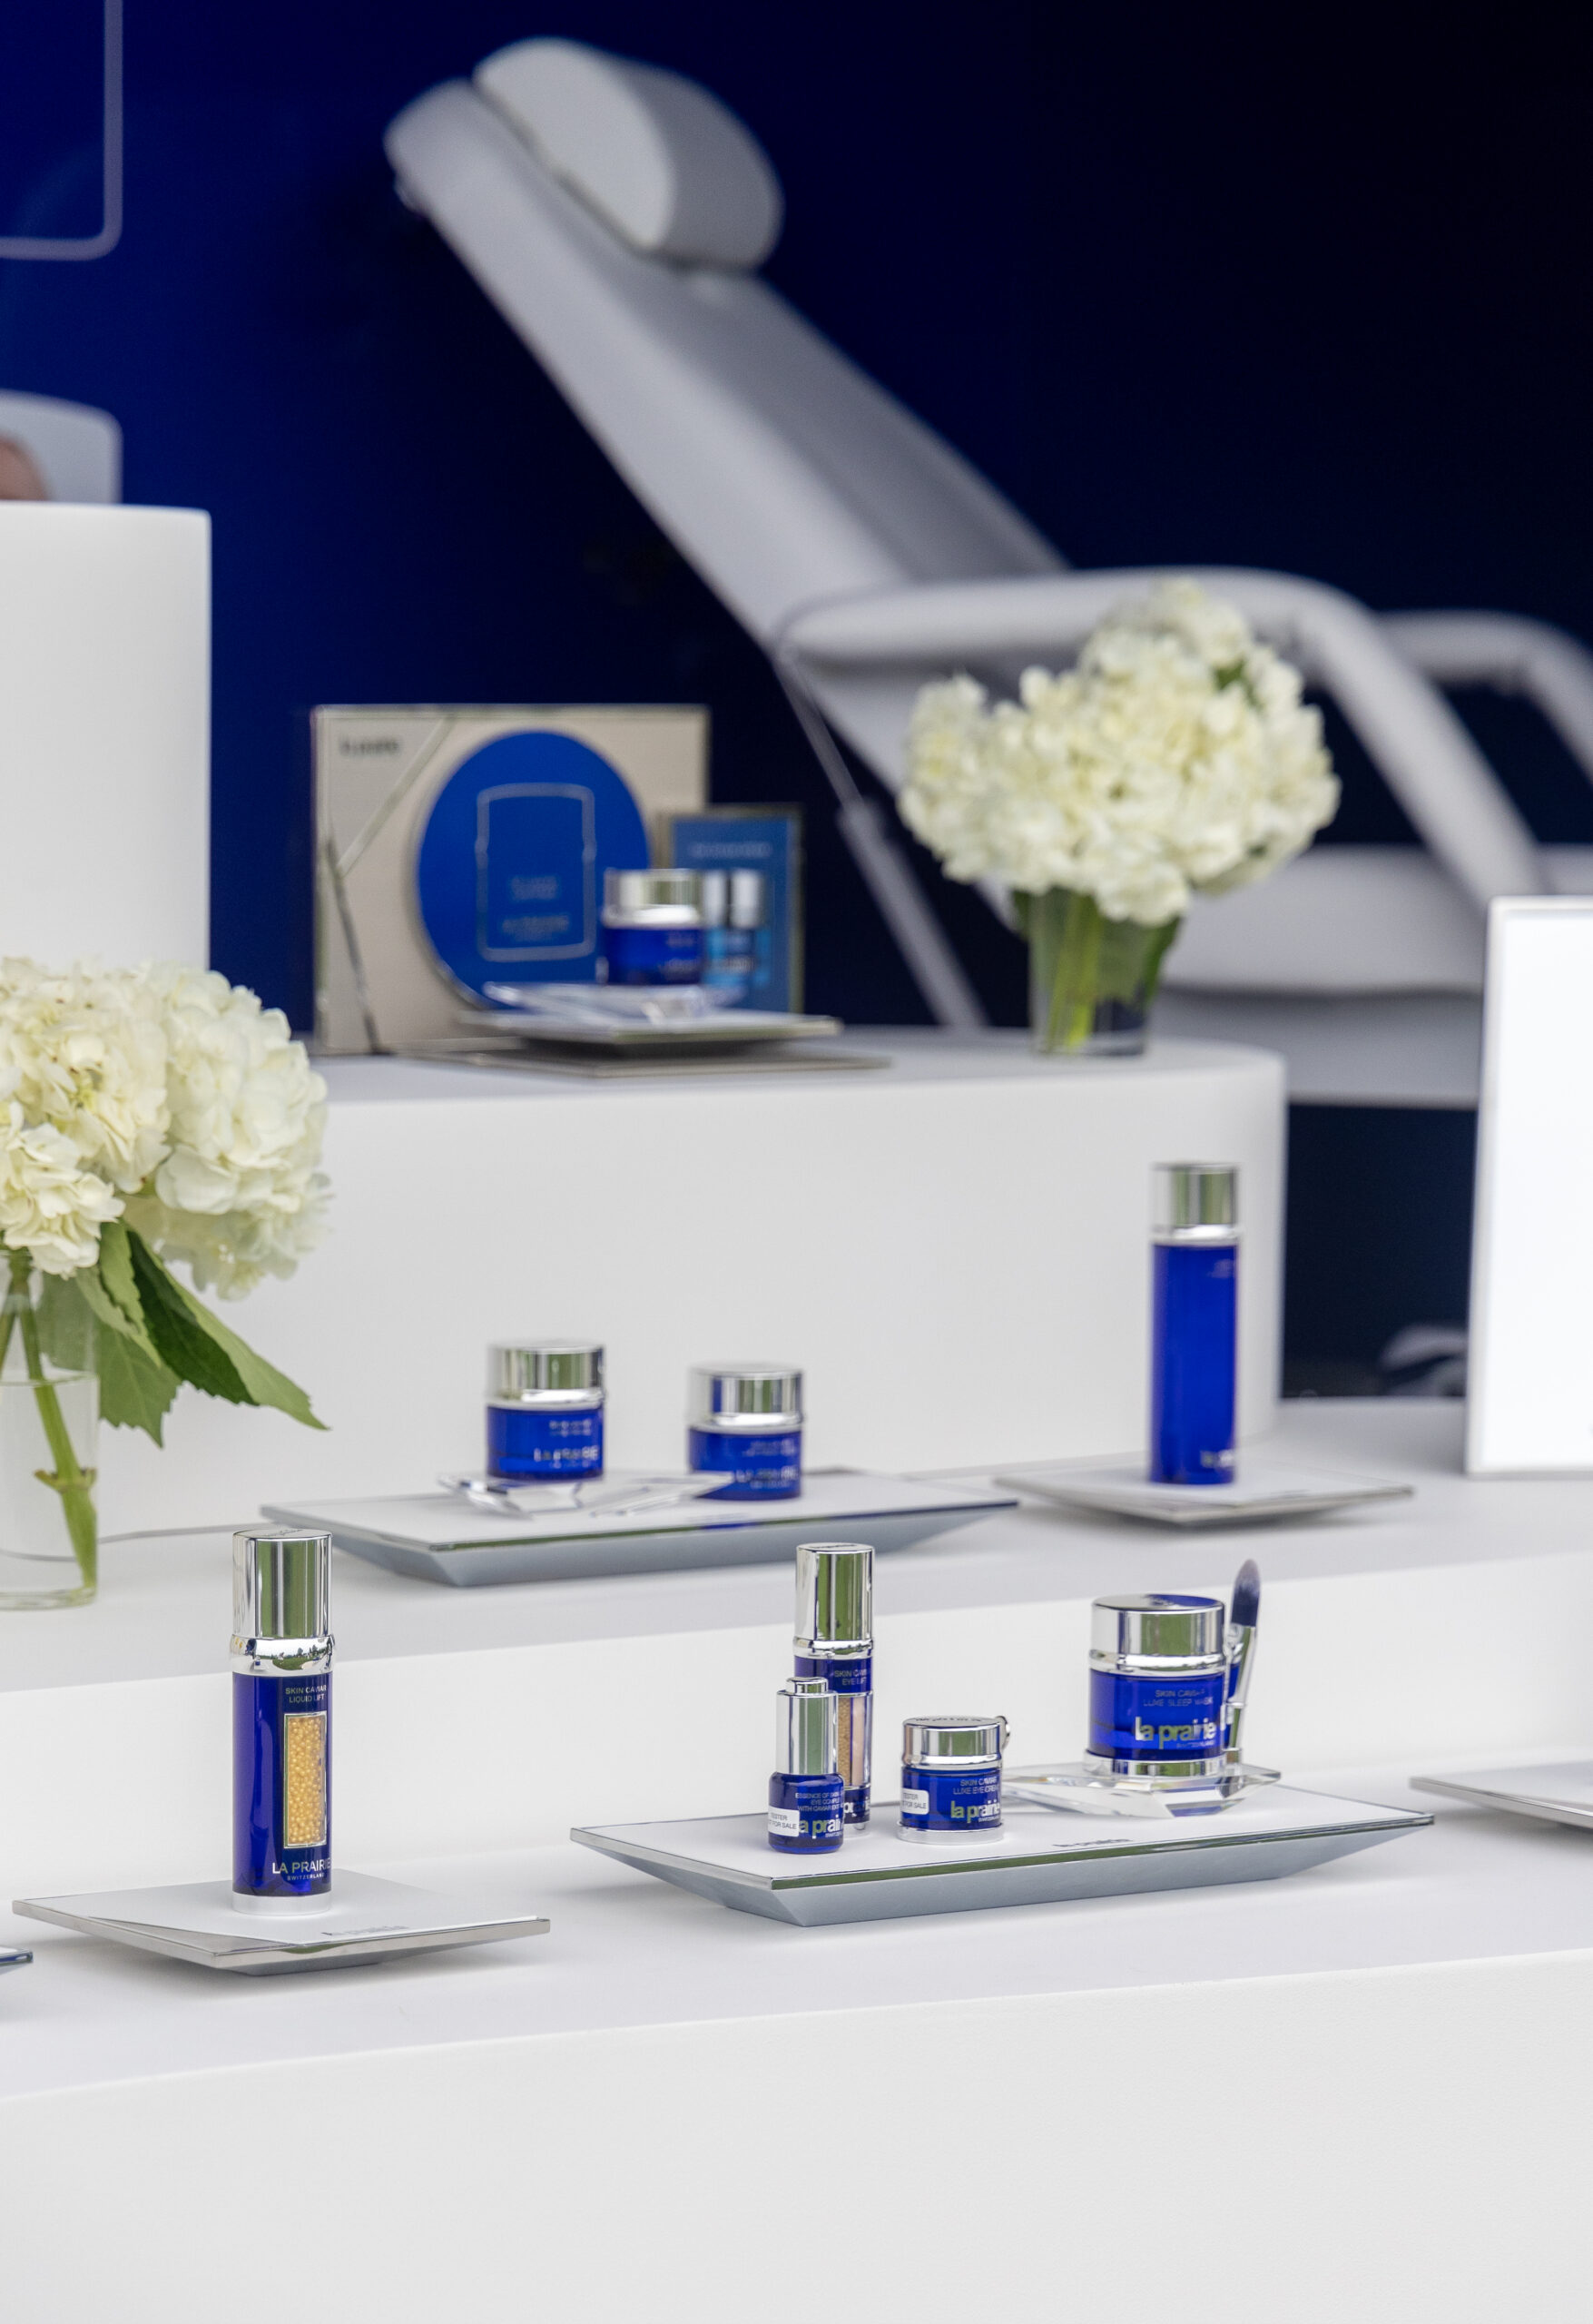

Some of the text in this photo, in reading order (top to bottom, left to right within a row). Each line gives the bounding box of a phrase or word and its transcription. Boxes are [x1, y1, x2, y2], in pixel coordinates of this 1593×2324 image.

[305, 1685, 327, 1694] CAVIAR
[289, 1696, 312, 1704] LIQUID
[1136, 1717, 1216, 1749] la prairie
[950, 1800, 965, 1818] la
[782, 1822, 797, 1830] SALE
[272, 1862, 288, 1874] LA
